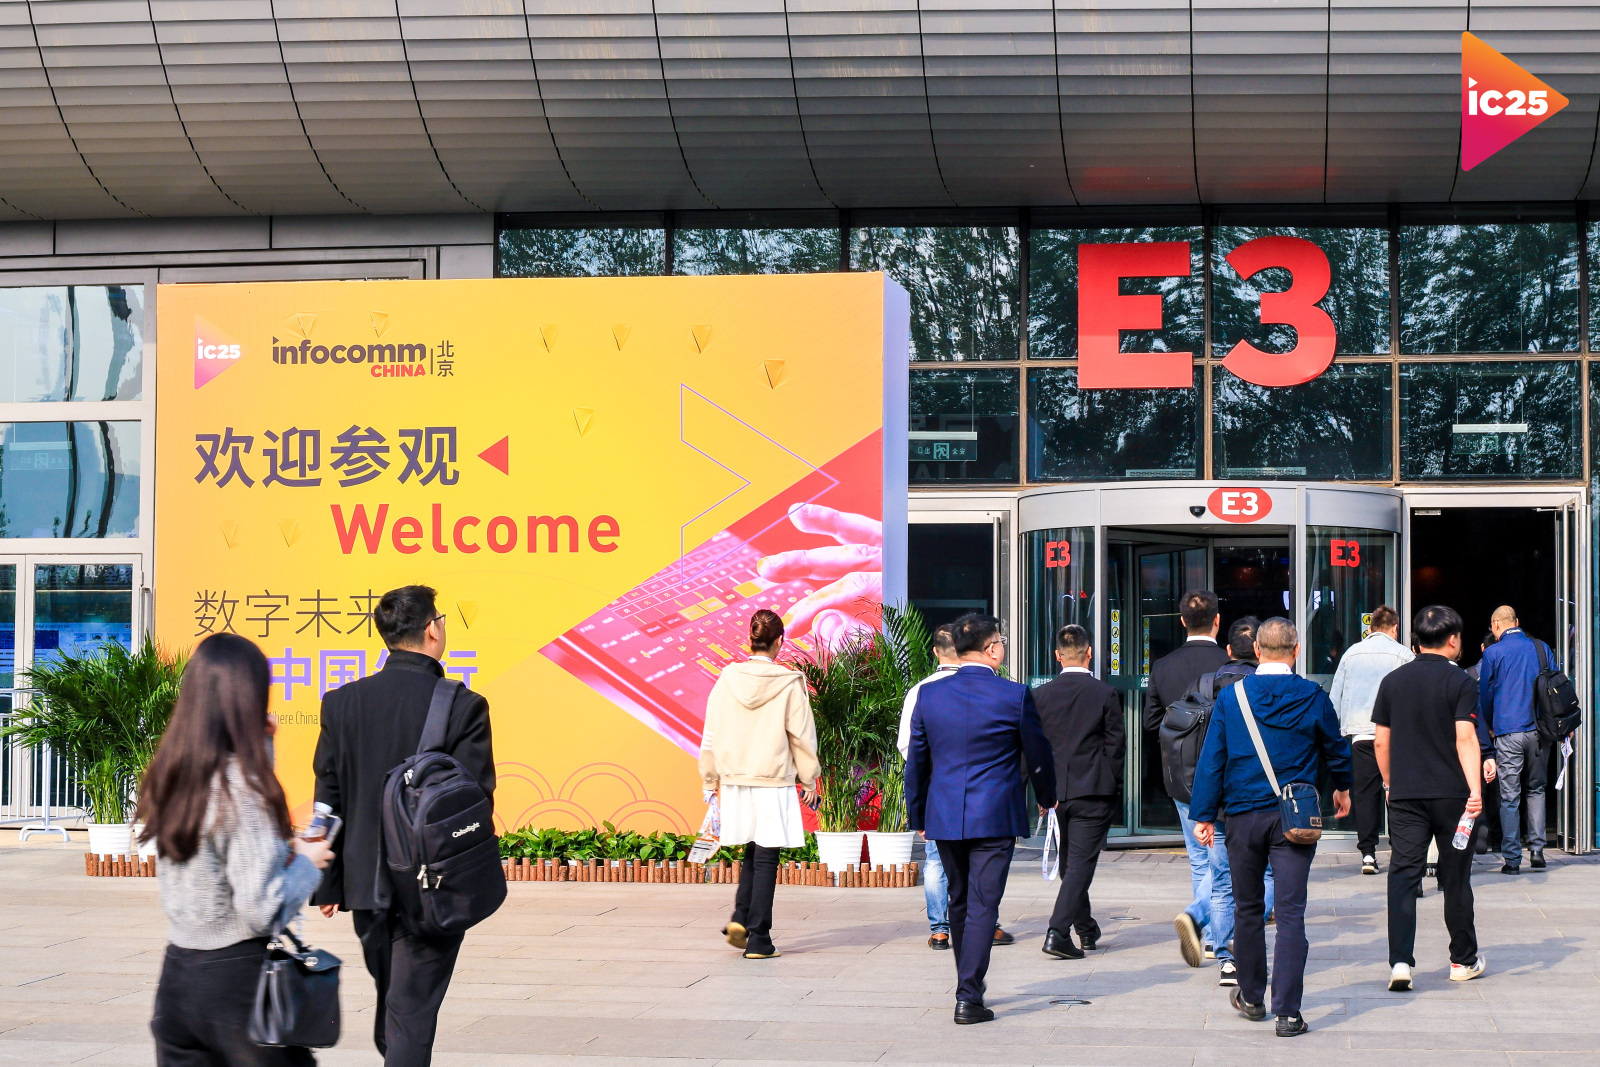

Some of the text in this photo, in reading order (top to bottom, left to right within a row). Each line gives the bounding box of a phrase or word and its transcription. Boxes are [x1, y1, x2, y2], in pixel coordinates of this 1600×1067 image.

[1077, 237, 1337, 390] E3
[272, 336, 427, 365] infocomm
[437, 340, 455, 377] 北京
[370, 364, 426, 378] CHINA
[194, 425, 460, 488] 欢迎参观
[1220, 491, 1260, 516] E3
[330, 503, 620, 555] Welcome
[1046, 540, 1071, 568] E3
[1330, 539, 1361, 568] E3
[266, 647, 479, 701] 中国行
[295, 711, 318, 725] China
